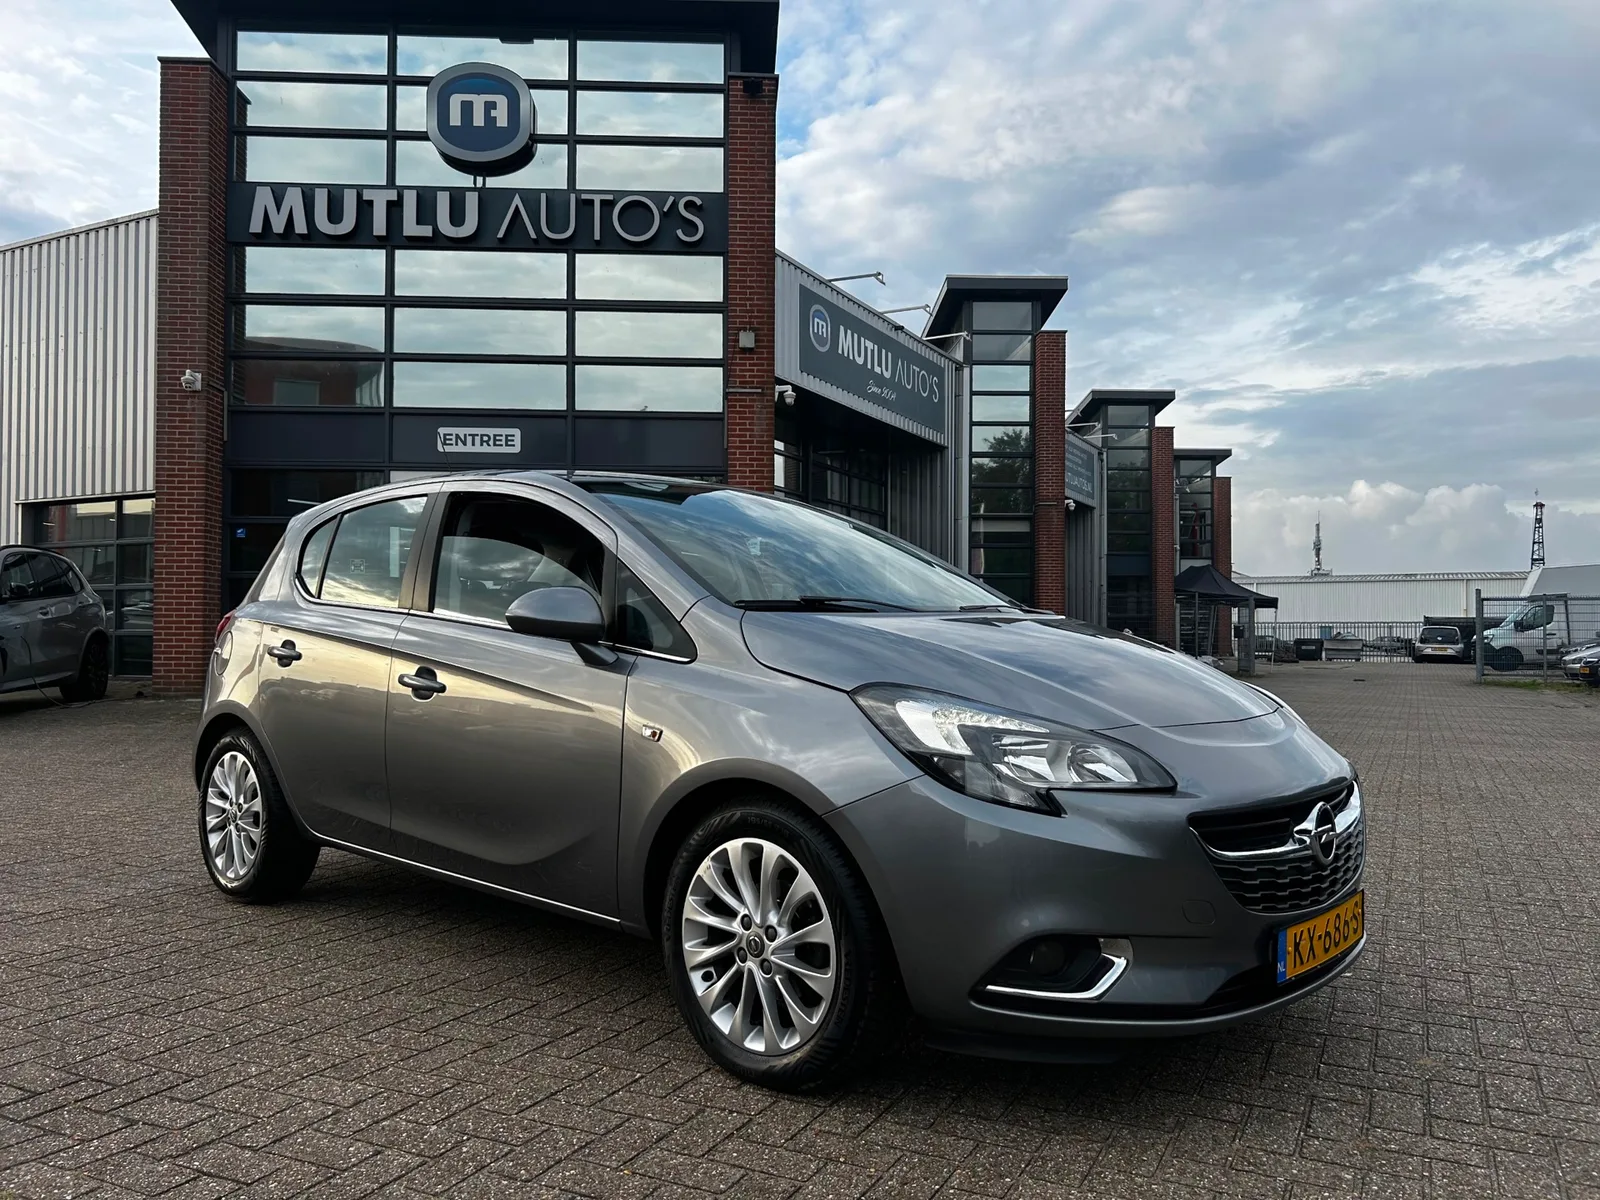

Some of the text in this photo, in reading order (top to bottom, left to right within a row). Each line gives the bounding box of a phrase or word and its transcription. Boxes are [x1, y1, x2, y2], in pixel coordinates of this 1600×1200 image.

[248, 186, 706, 243] MUTLU AUTO'S
[838, 324, 939, 403] MUTLU AUTO'S
[442, 433, 516, 447] ENTREE
[1293, 900, 1359, 969] KX-686-S
[1277, 961, 1286, 974] NL
